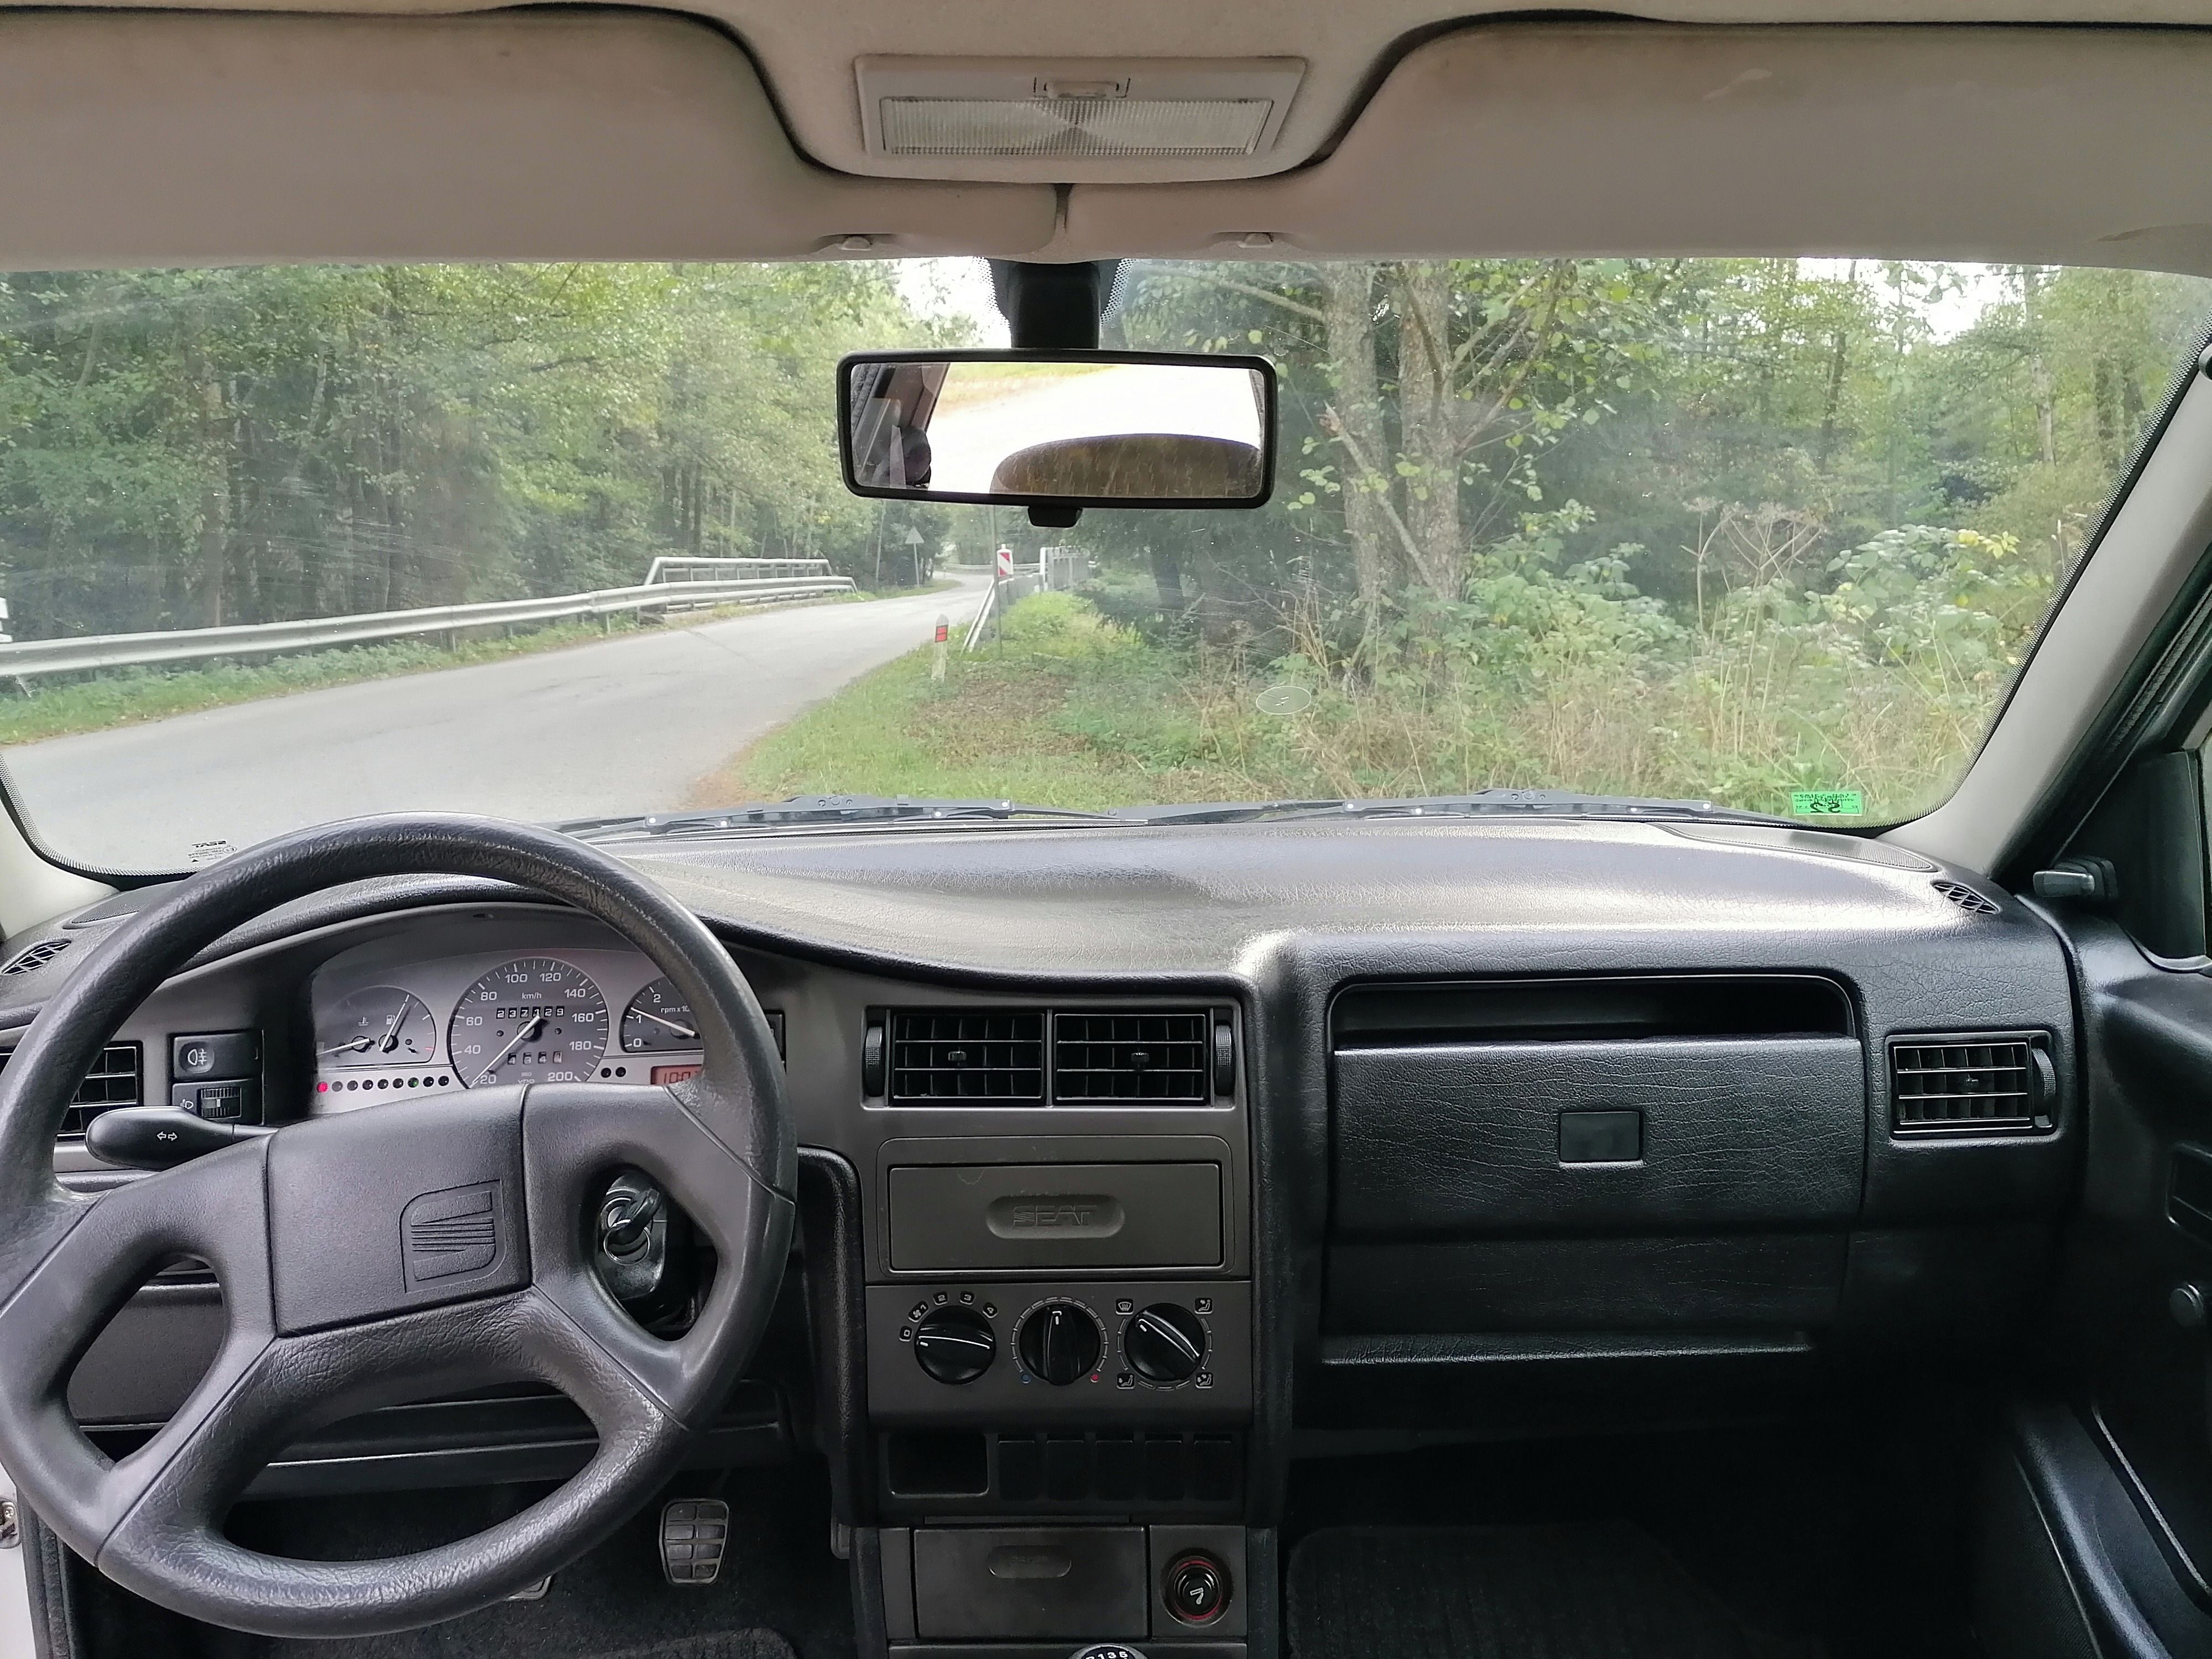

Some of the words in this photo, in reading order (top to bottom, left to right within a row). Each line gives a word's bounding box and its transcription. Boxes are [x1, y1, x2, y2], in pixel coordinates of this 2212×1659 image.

[505, 974, 528, 983] 100
[539, 972, 561, 982] 120
[480, 992, 497, 1000] 80
[564, 989, 586, 998] 140
[653, 994, 661, 1003] 2
[466, 1016, 482, 1026] 60
[572, 1013, 594, 1022] 160
[636, 1014, 641, 1024] 1
[570, 1041, 592, 1050] 180
[633, 1038, 641, 1047] 0
[464, 1045, 481, 1054] 40
[480, 1074, 497, 1084] 20
[547, 1072, 573, 1082] 200
[1013, 1205, 1097, 1227] SEAT
